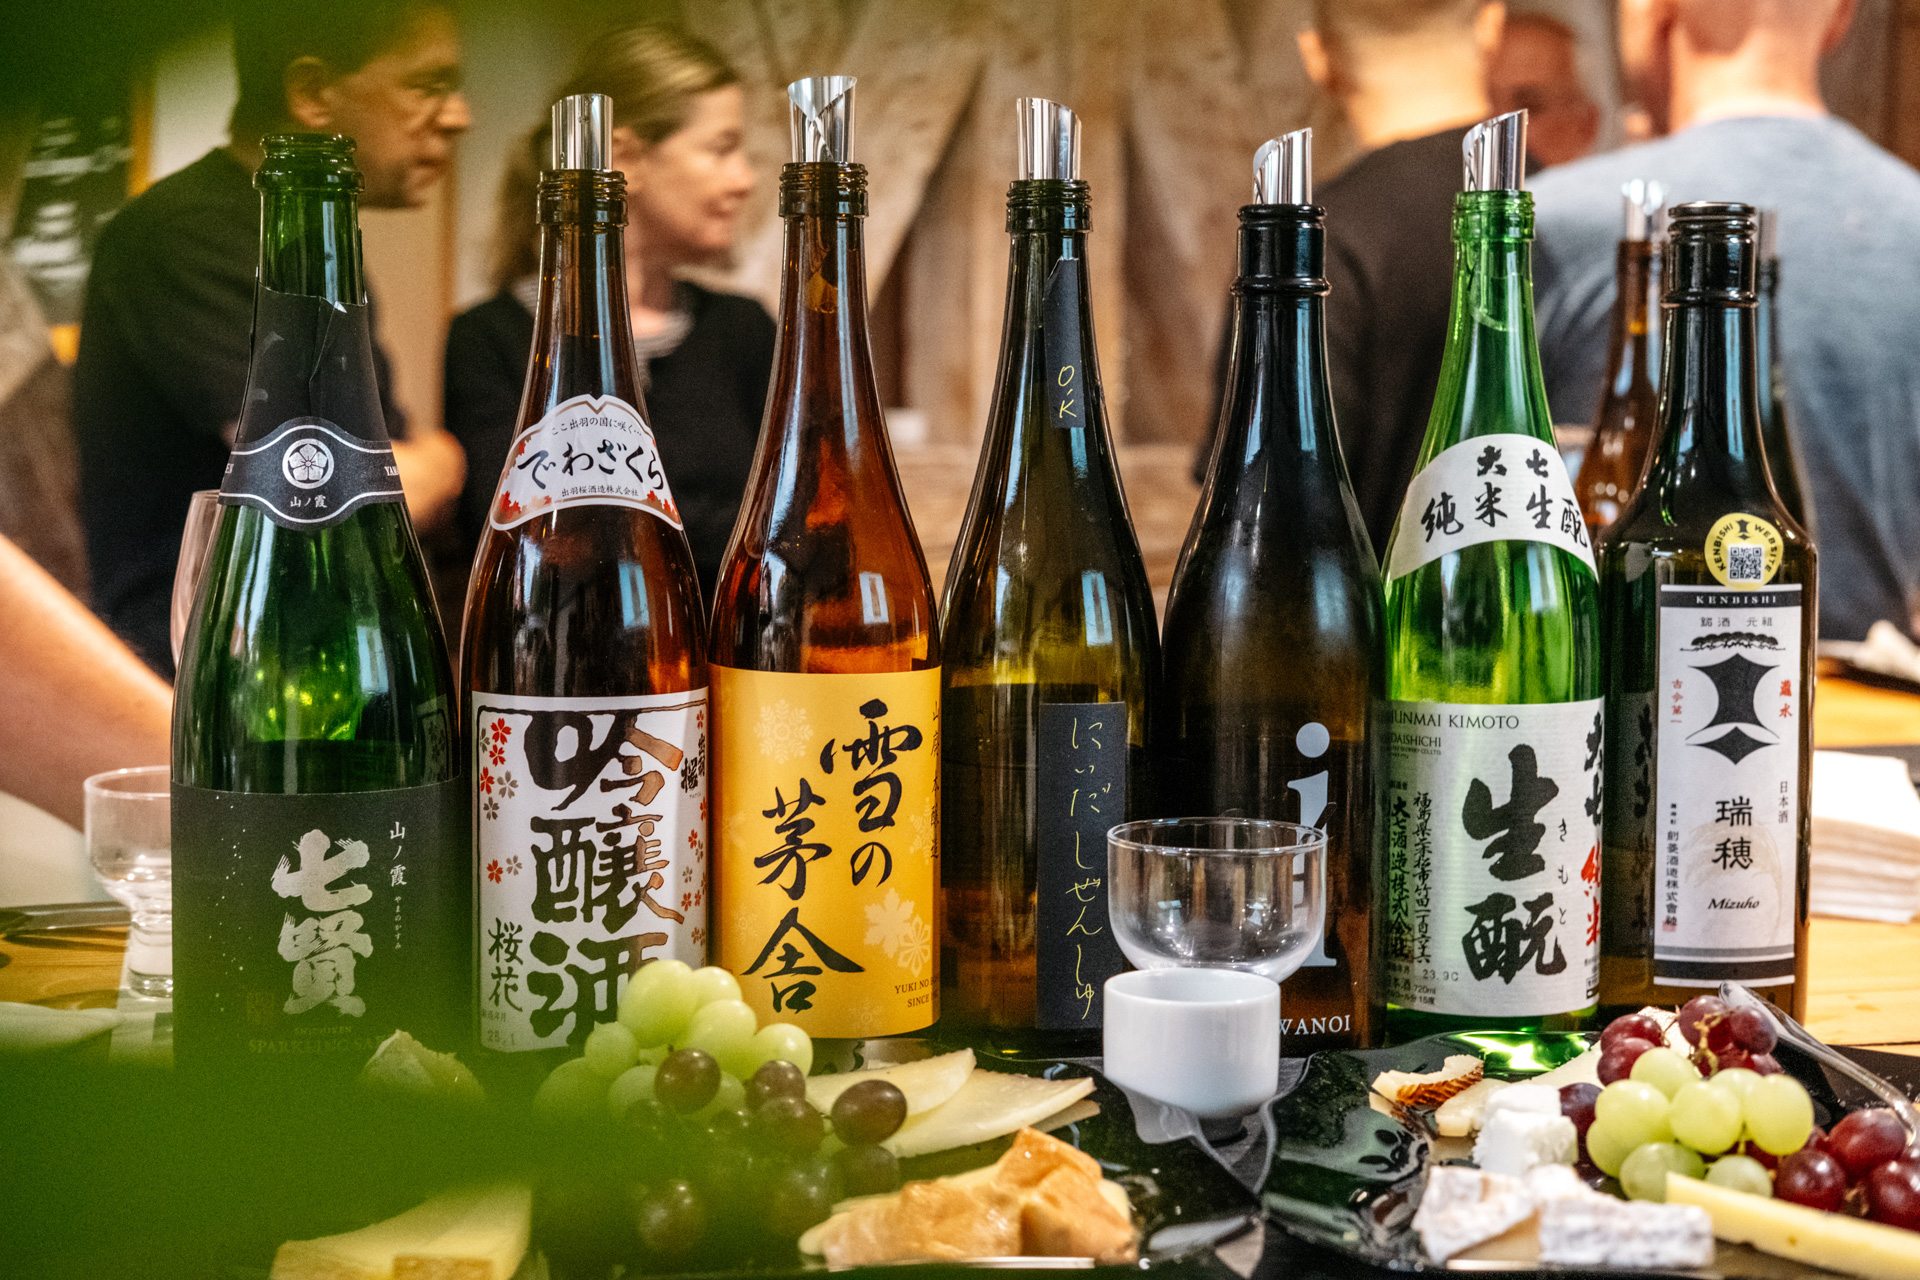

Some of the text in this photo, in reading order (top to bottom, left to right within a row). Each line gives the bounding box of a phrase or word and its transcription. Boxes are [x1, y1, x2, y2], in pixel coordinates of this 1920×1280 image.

[518, 439, 664, 490] でわざくら
[1477, 445, 1549, 478] 大七
[561, 485, 639, 497] 出羽桜酒造株式会社
[1712, 523, 1778, 573] KENBISHI WEBSITE
[1696, 595, 1777, 605] KENBISHI
[1391, 733, 1442, 748] DAISHICHI
[1449, 714, 1520, 730] KIMOTO
[820, 698, 923, 888] 雪の
[1778, 780, 1789, 824] 日本酒
[390, 821, 407, 887] 山ノ霞
[1712, 796, 1753, 870] 瑞穂
[1065, 717, 1111, 1020] にいだしぜんしゅ
[1461, 743, 1567, 985] 生酛
[1558, 818, 1568, 925] きもと
[271, 829, 374, 1017] 七賢
[1707, 896, 1760, 910] Mizuho
[487, 917, 524, 1013] 桜花
[894, 981, 917, 994] YUKI
[919, 978, 930, 990] NO
[906, 993, 930, 1008] SINCE
